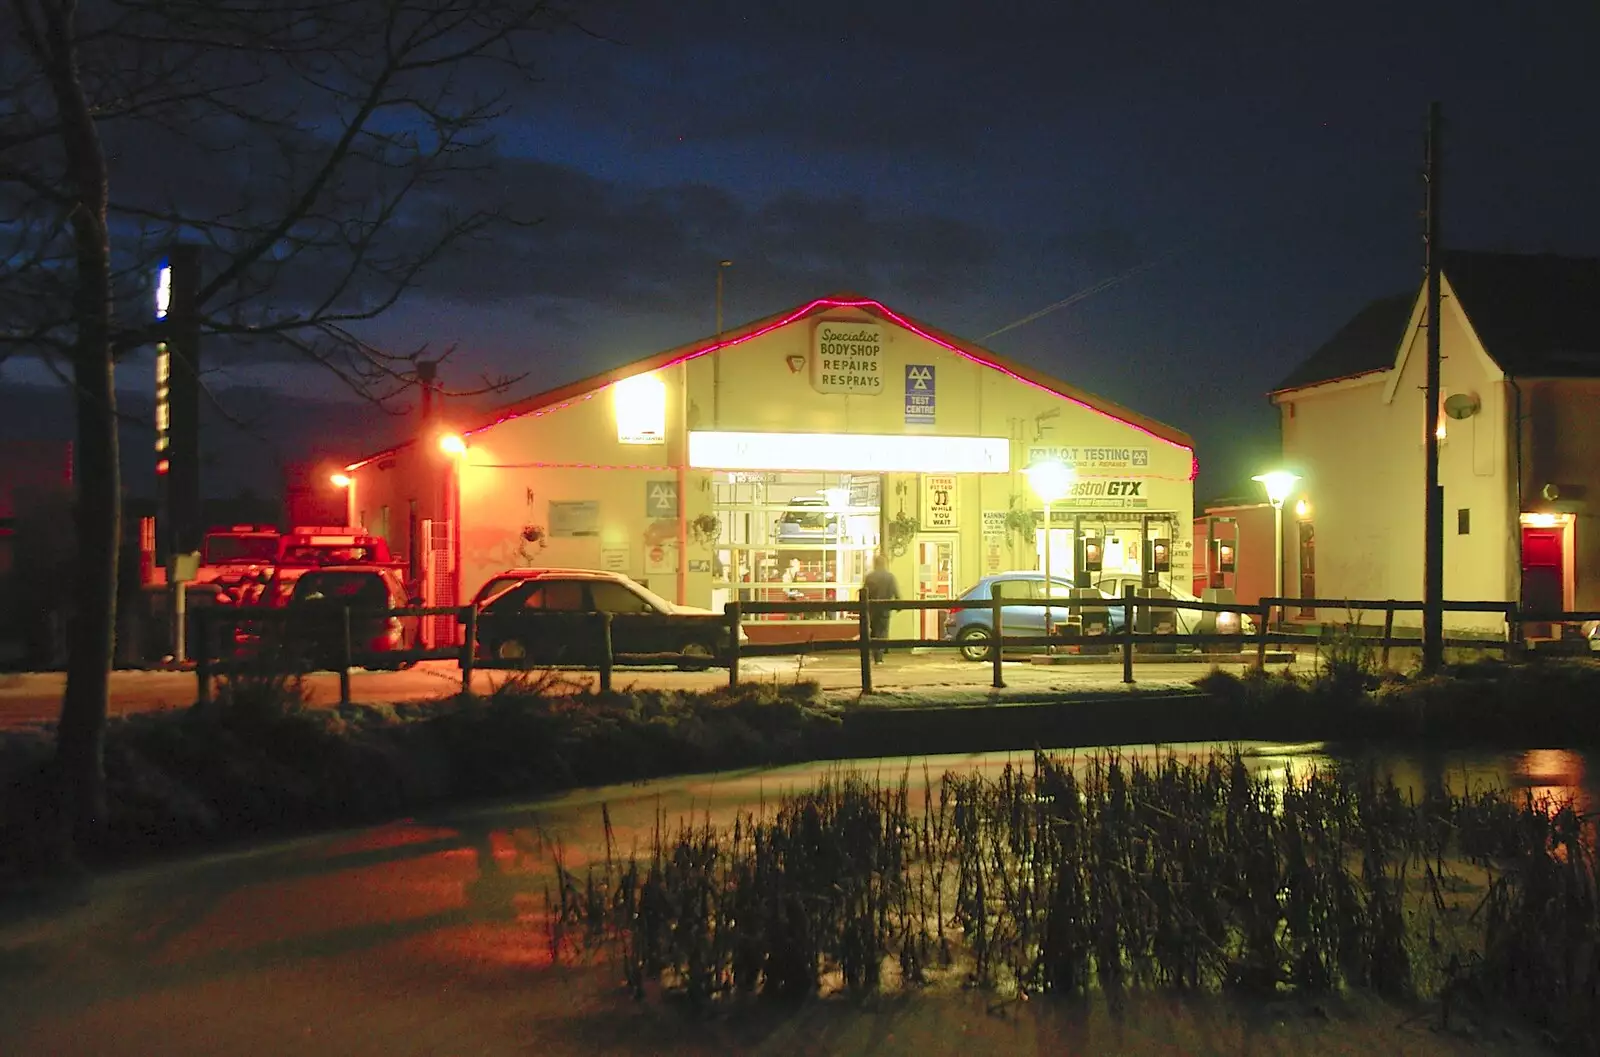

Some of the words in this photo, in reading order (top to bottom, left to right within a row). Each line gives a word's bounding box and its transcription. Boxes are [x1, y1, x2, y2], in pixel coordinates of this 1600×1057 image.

[822, 328, 880, 343] Specialist
[820, 343, 880, 356] BODYSHOP
[823, 360, 877, 371] REPAIRS
[822, 374, 880, 386] RESPRAYS
[911, 397, 930, 405] TEST
[906, 405, 935, 414] CENTRE
[1084, 448, 1130, 461] TESTING
[1069, 481, 1106, 495] astrol
[1107, 481, 1142, 496] GTX
